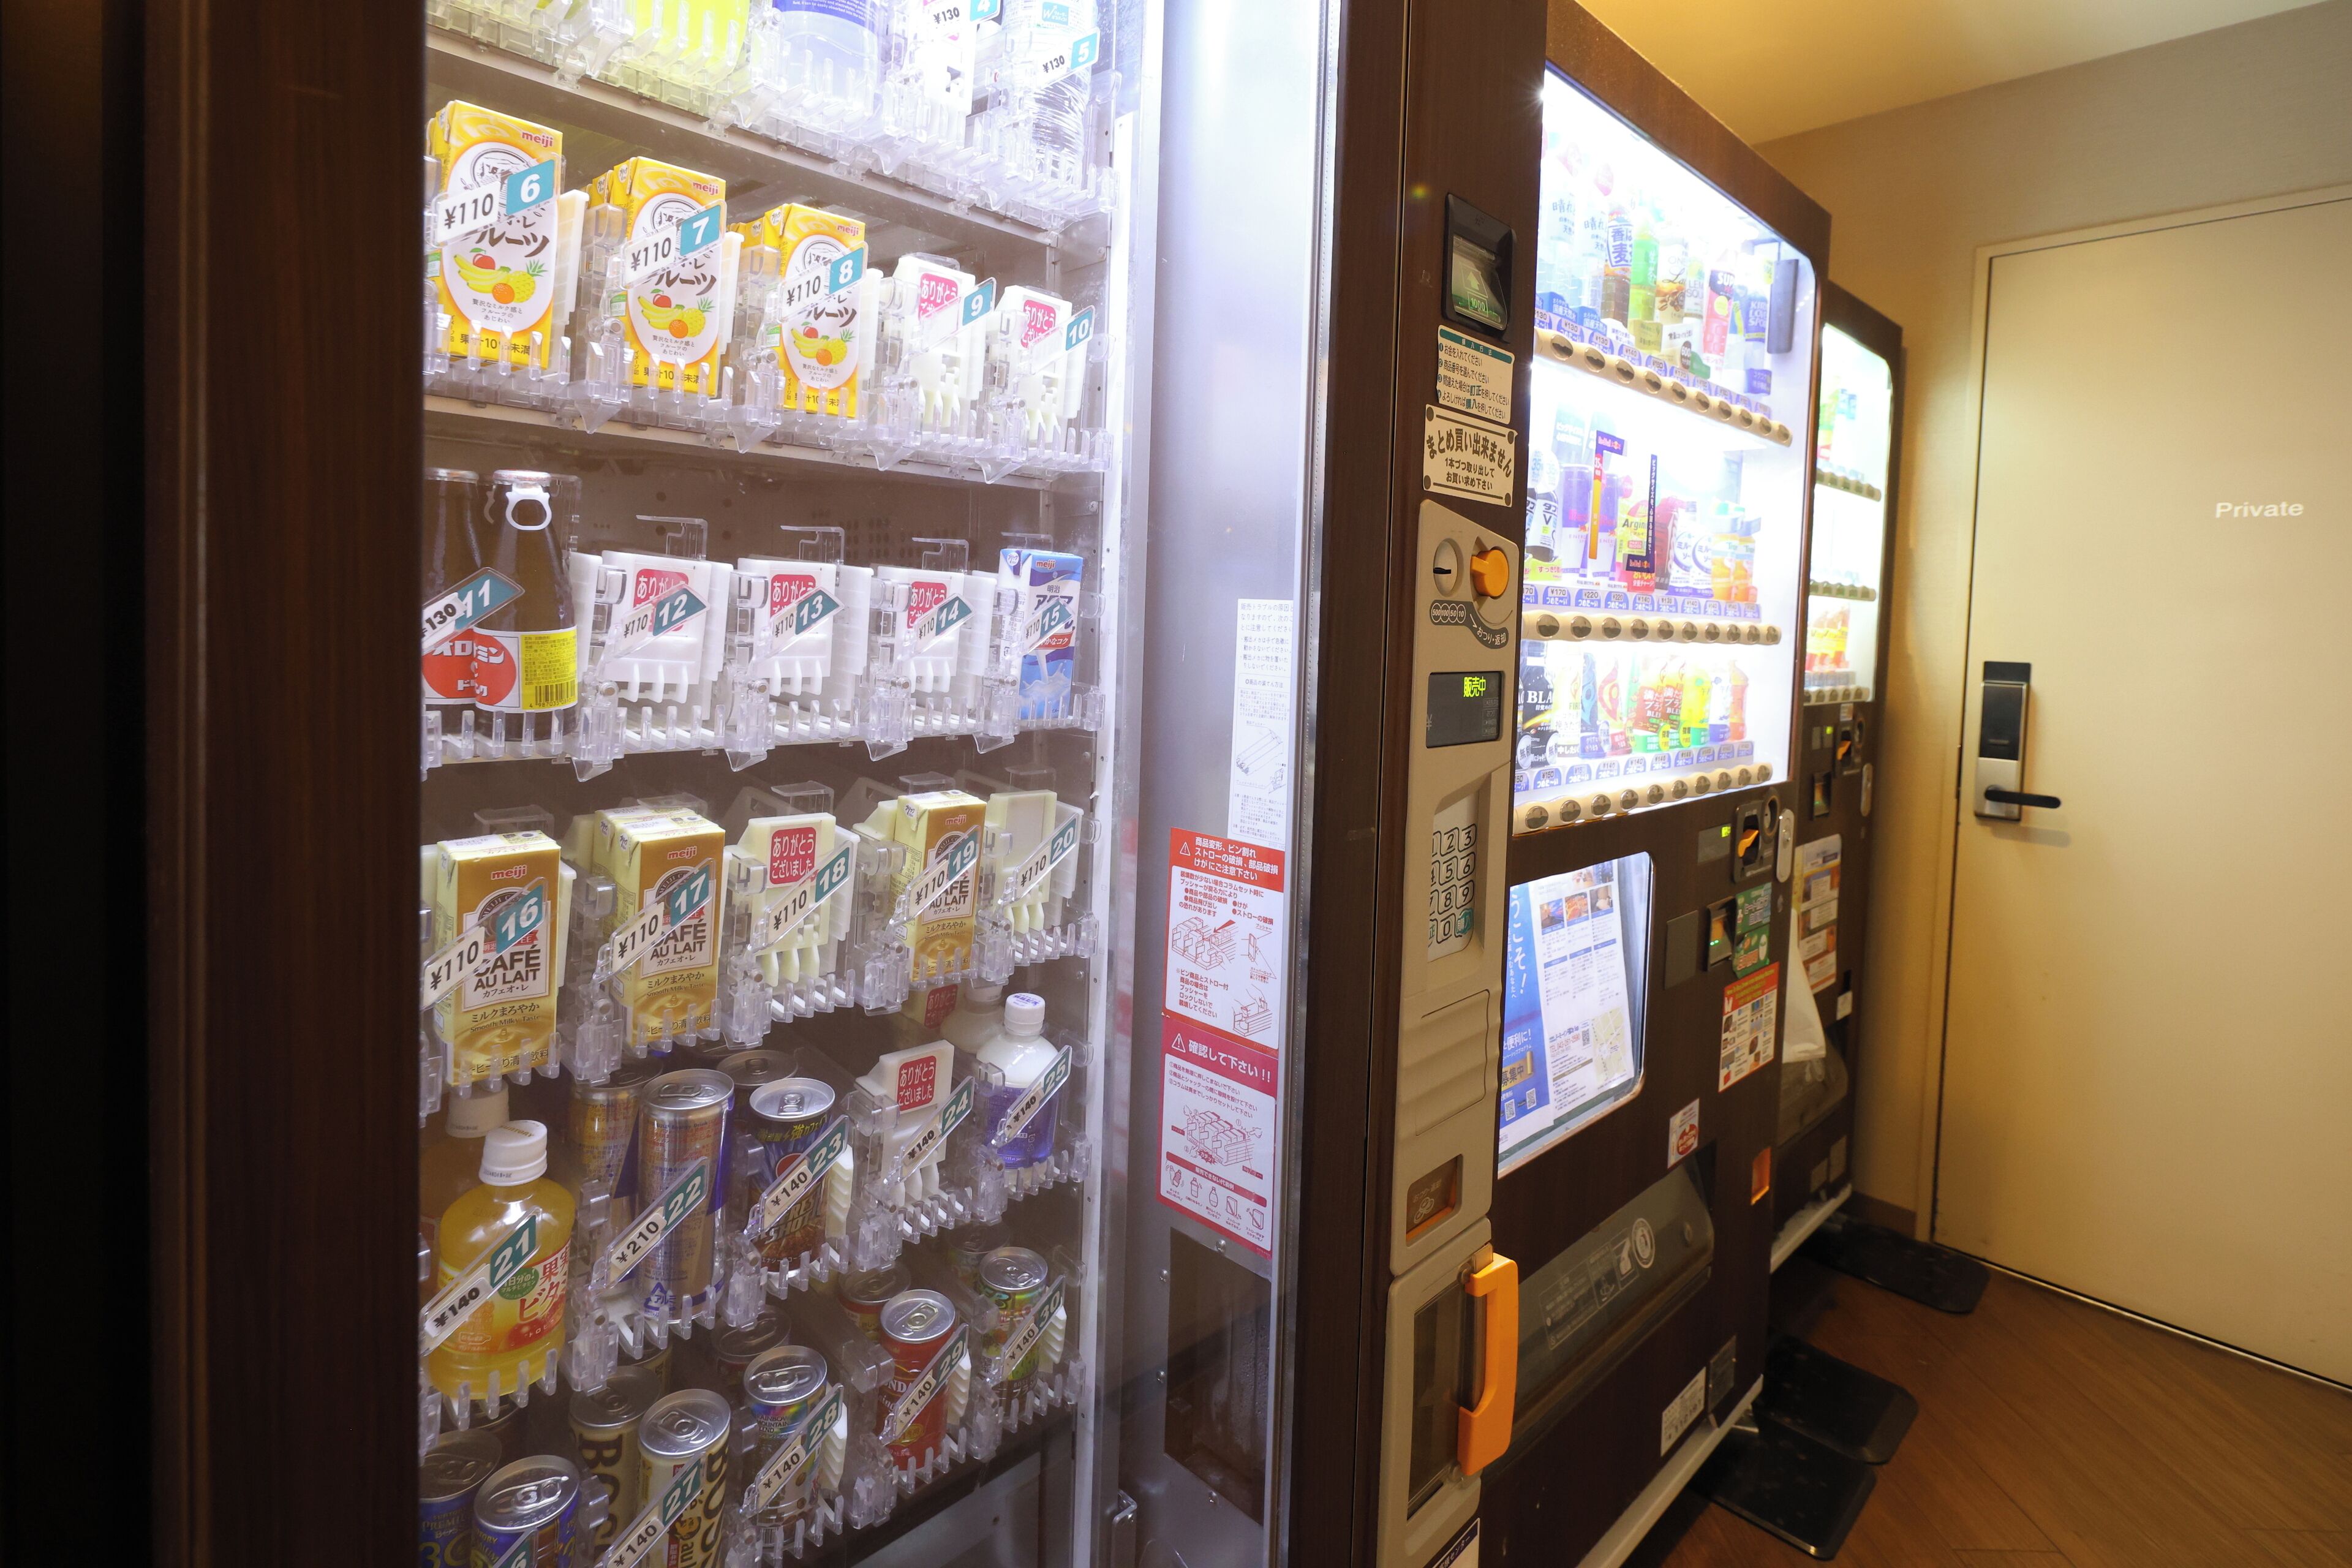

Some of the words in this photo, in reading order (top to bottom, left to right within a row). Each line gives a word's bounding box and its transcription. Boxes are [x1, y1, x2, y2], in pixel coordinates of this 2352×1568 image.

[933, 7, 960, 24] ¥130
[1078, 41, 1090, 62] 5
[1042, 55, 1065, 73] ¥130
[522, 131, 554, 148] meiji
[521, 174, 540, 203] 6
[693, 182, 718, 195] meiji
[444, 194, 494, 229] ¥110
[693, 216, 709, 245] 7
[837, 225, 859, 236] meiji
[631, 237, 671, 271] ¥110
[839, 260, 853, 284] 8
[786, 276, 821, 306] ¥110
[921, 278, 957, 304] ありがとう
[971, 294, 983, 317] 9
[1471, 297, 1486, 311] 1000
[1025, 304, 1055, 331] ありがとう
[1564, 322, 1578, 333] ¥130
[1069, 318, 1089, 345] 10
[1595, 334, 1608, 346] ¥130
[1444, 344, 1483, 366] お金を入れてください
[1443, 359, 1490, 384] 商品番号を選んでください
[1426, 428, 1512, 478] まとめ買い出来ません
[1444, 457, 1494, 478] 1本づつ取り出して
[1446, 470, 1493, 491] お買い求め下さい
[2215, 501, 2304, 518] Private
[1036, 560, 1055, 569] meiji
[910, 587, 946, 608] ありがとう
[1047, 585, 1060, 594] 明治
[1550, 587, 1566, 596] ¥170
[658, 594, 687, 627] 12
[800, 595, 823, 626] 13
[940, 602, 959, 629] 14
[1043, 605, 1060, 631] 15
[1240, 602, 1294, 612] 販売トラブルの原因と
[1458, 609, 1464, 617] 10
[624, 614, 648, 639] ¥110
[775, 613, 794, 638] ¥110
[919, 620, 935, 640] ¥110
[1026, 619, 1040, 639] ¥110
[1477, 626, 1507, 646] おつり・返却
[1463, 676, 1486, 698] 販売中
[946, 814, 967, 825] meiji
[772, 834, 815, 857] ありがとう
[1051, 826, 1074, 860] 20
[1195, 837, 1257, 859] 商品変形、ビン割れ
[1446, 832, 1454, 846] 2
[1464, 829, 1472, 846] 3
[668, 846, 697, 859] meiji
[952, 840, 975, 872] 19
[1194, 847, 1278, 875] ストローの破損、部品破損
[491, 865, 527, 880] meiji
[772, 856, 813, 879] ございました
[819, 857, 845, 893] 18
[1020, 854, 1047, 888] ¥110
[1194, 858, 1257, 881] けがにご注意下さい
[1446, 865, 1453, 879] 5
[1463, 862, 1471, 875] 6
[675, 873, 706, 915] 17
[915, 870, 945, 907] ¥110
[1444, 894, 1452, 908] 8
[1462, 886, 1469, 899] 9
[774, 890, 807, 931] ¥110
[929, 899, 941, 910] AU
[945, 895, 968, 907] LAIT
[1179, 902, 1217, 917] の恐れがあります
[502, 897, 538, 941] 16
[926, 921, 966, 933] ミルクまろやか
[1443, 921, 1450, 937] 0
[618, 914, 658, 959] ¥110
[650, 948, 669, 960] AU
[674, 940, 706, 955] LAIT
[657, 954, 696, 967] カフェオ・レ
[431, 940, 479, 990] ¥110
[473, 975, 497, 992] AU
[502, 968, 540, 984] LAIT
[483, 984, 529, 999] カフェオ・レ
[647, 972, 705, 989] ミルクまろやか
[1180, 977, 1209, 992] 商品の場合は
[647, 988, 669, 998] Smooth
[1013, 995, 1039, 1006] カルピス
[1179, 992, 1213, 1009] ロックしないで
[1180, 985, 1208, 999] プッシャーを
[472, 1003, 540, 1023] ミルクまろやか
[1178, 999, 1218, 1018] 装填してください
[470, 1022, 497, 1033] Smooth
[900, 1061, 935, 1086] ありがとう
[1045, 1058, 1067, 1090] 25
[899, 1087, 933, 1106] ございました
[944, 1091, 968, 1130] 24
[1013, 1095, 1037, 1124] ¥140
[499, 1125, 535, 1138] SUNTORY
[814, 1132, 842, 1175] 23
[907, 1129, 935, 1160] ¥140
[667, 1175, 702, 1221] 22
[771, 1170, 809, 1207] ¥140
[616, 1220, 660, 1263] ¥210
[494, 1227, 530, 1284] 21
[434, 1287, 480, 1328] ¥140
[1039, 1291, 1061, 1329] 30
[1008, 1328, 1035, 1361] ¥140
[939, 1341, 963, 1381] 29
[902, 1380, 932, 1418] ¥140
[808, 1402, 838, 1449] 28
[762, 1452, 801, 1489] ¥140
[665, 1466, 699, 1521] 27
[613, 1524, 658, 1567] ¥140
